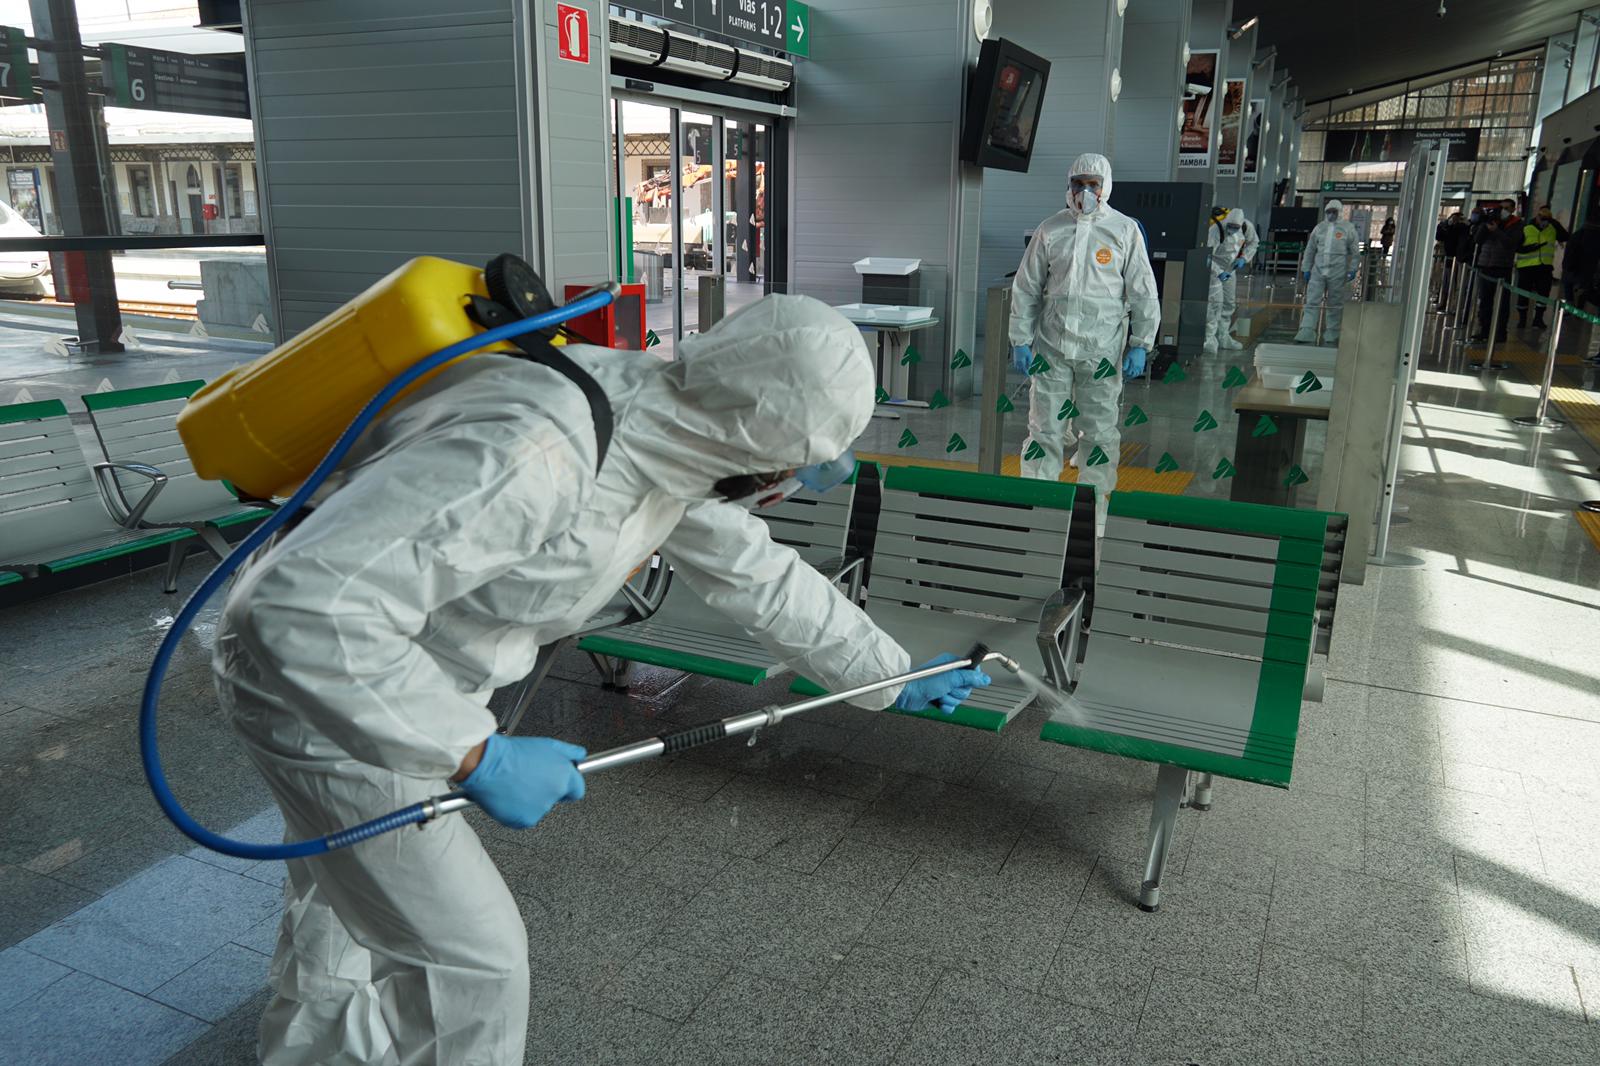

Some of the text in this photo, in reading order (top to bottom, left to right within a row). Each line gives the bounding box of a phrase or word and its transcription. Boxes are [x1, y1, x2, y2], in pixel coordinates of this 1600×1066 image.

[728, 15, 756, 32] PLATFORMS
[0, 62, 11, 88] 7
[131, 78, 145, 102] 6
